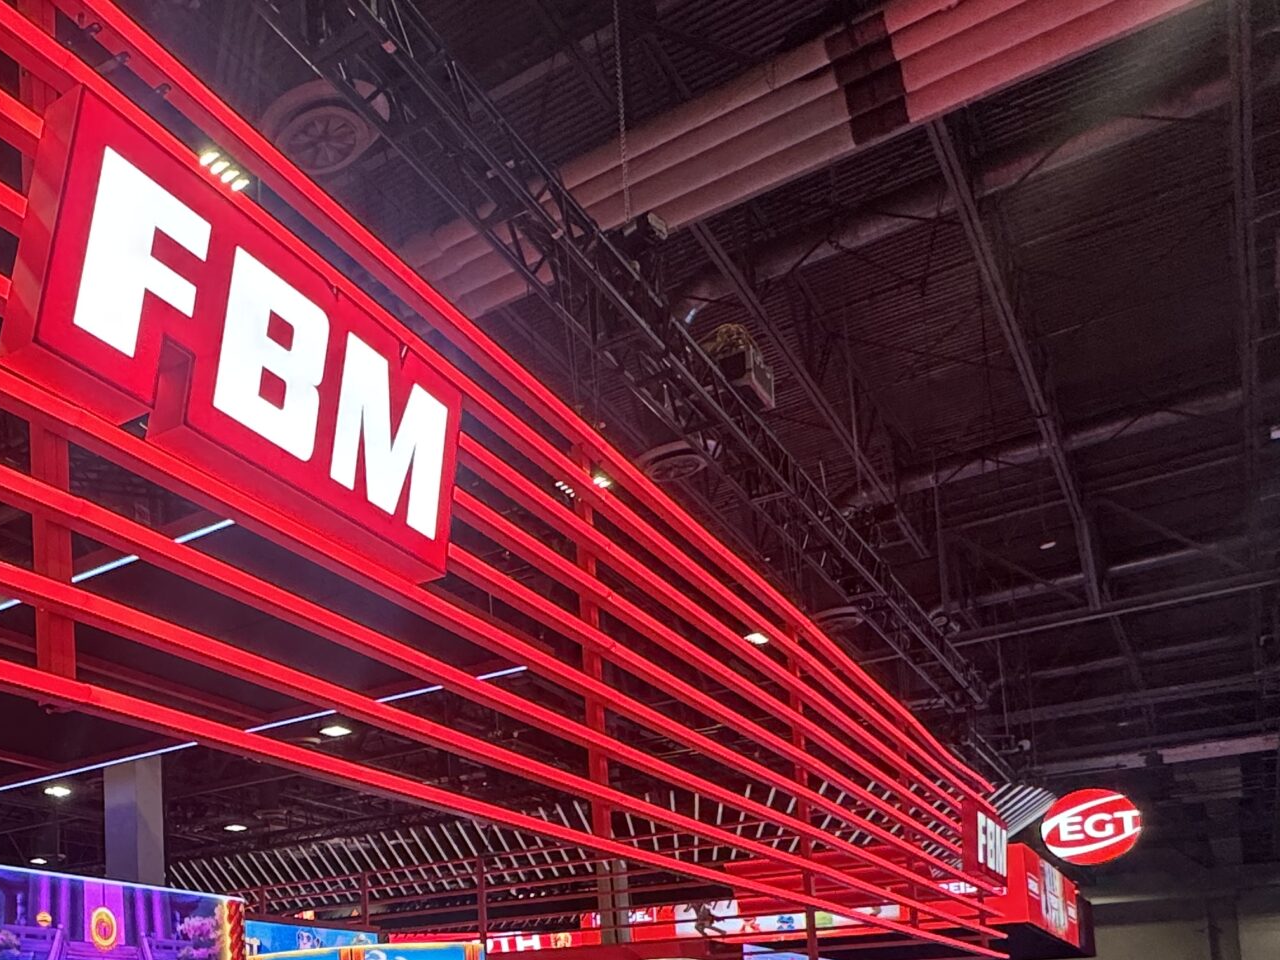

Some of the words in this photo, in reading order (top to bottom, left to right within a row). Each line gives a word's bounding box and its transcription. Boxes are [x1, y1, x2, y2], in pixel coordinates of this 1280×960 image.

[72, 145, 449, 541] FBM
[977, 810, 1007, 877] FBM
[1059, 809, 1142, 841] EGT
